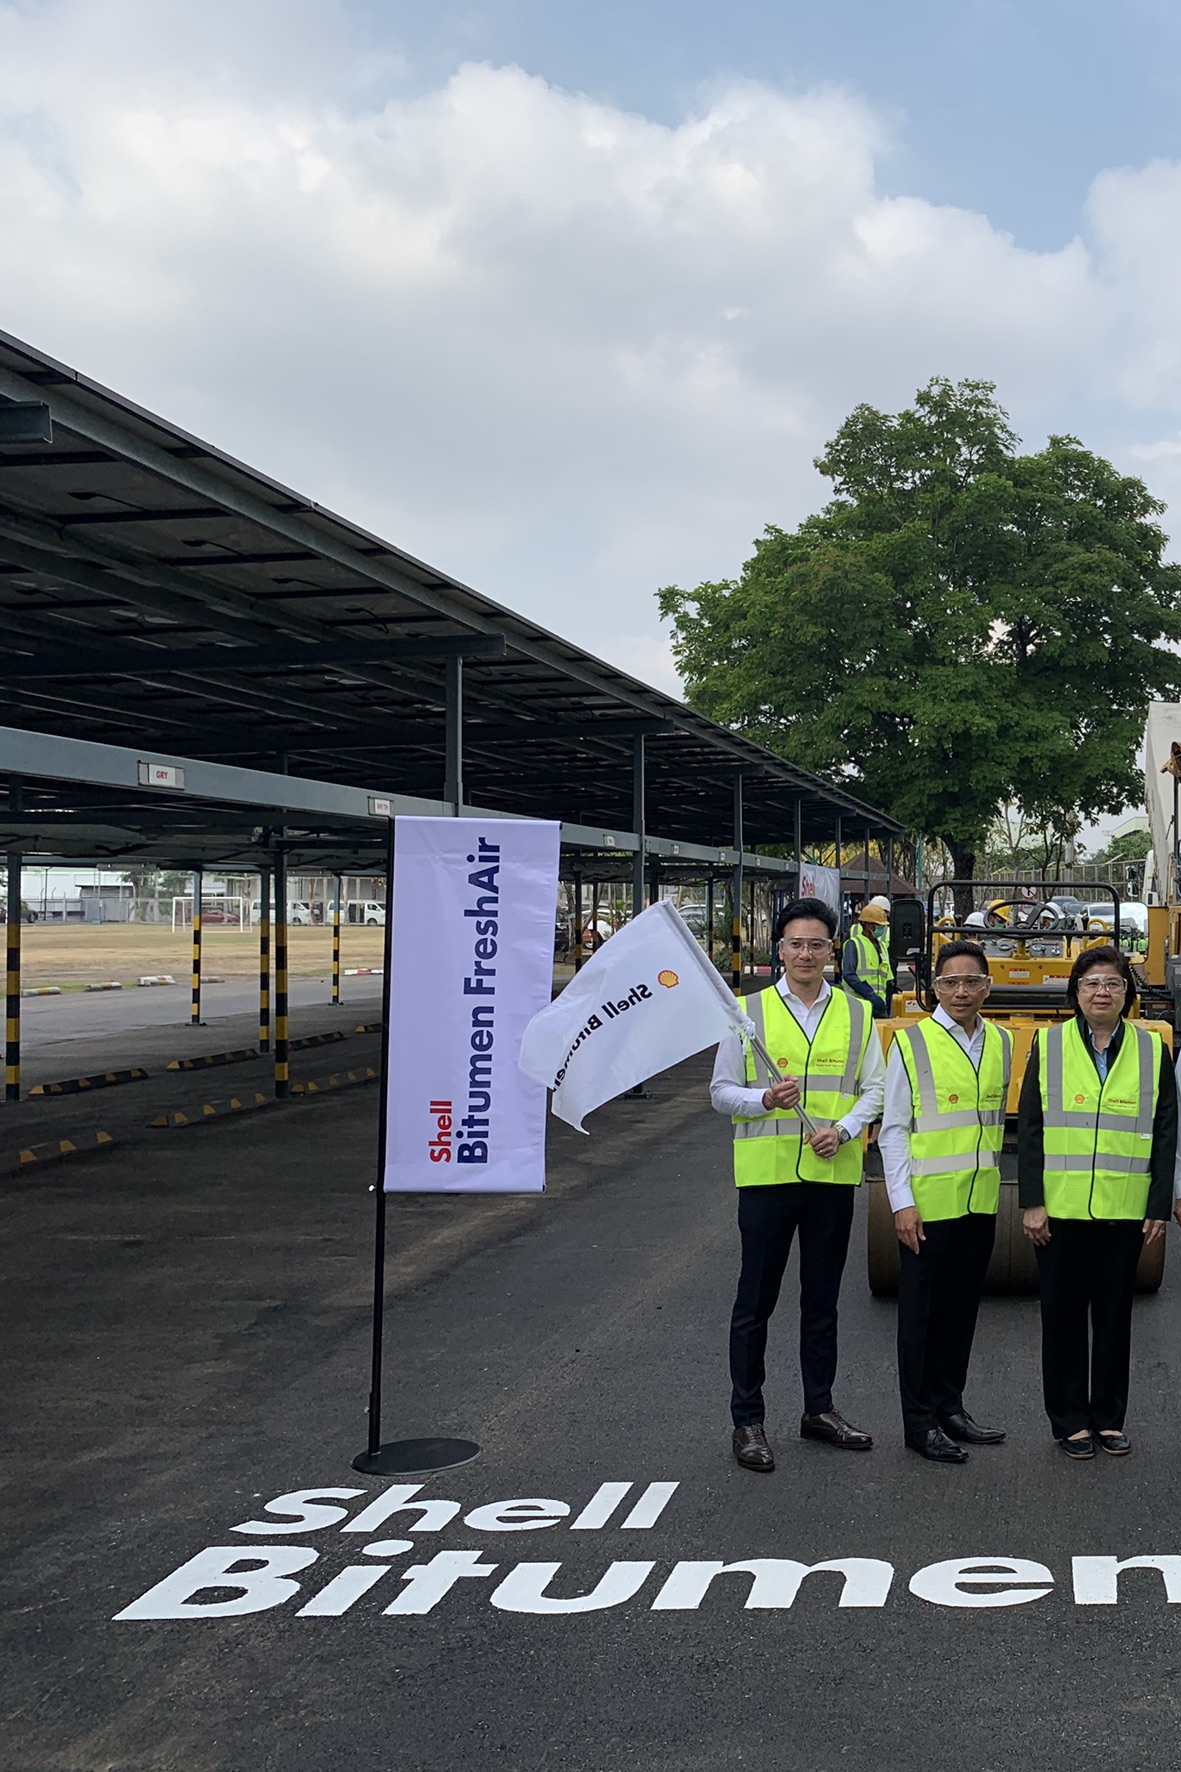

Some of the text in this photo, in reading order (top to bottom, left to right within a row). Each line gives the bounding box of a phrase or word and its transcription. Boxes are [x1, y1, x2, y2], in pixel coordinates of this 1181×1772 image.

[456, 836, 501, 1164] Bitumen FreshAir
[429, 1100, 453, 1162] Shell
[229, 1482, 680, 1535] Shell
